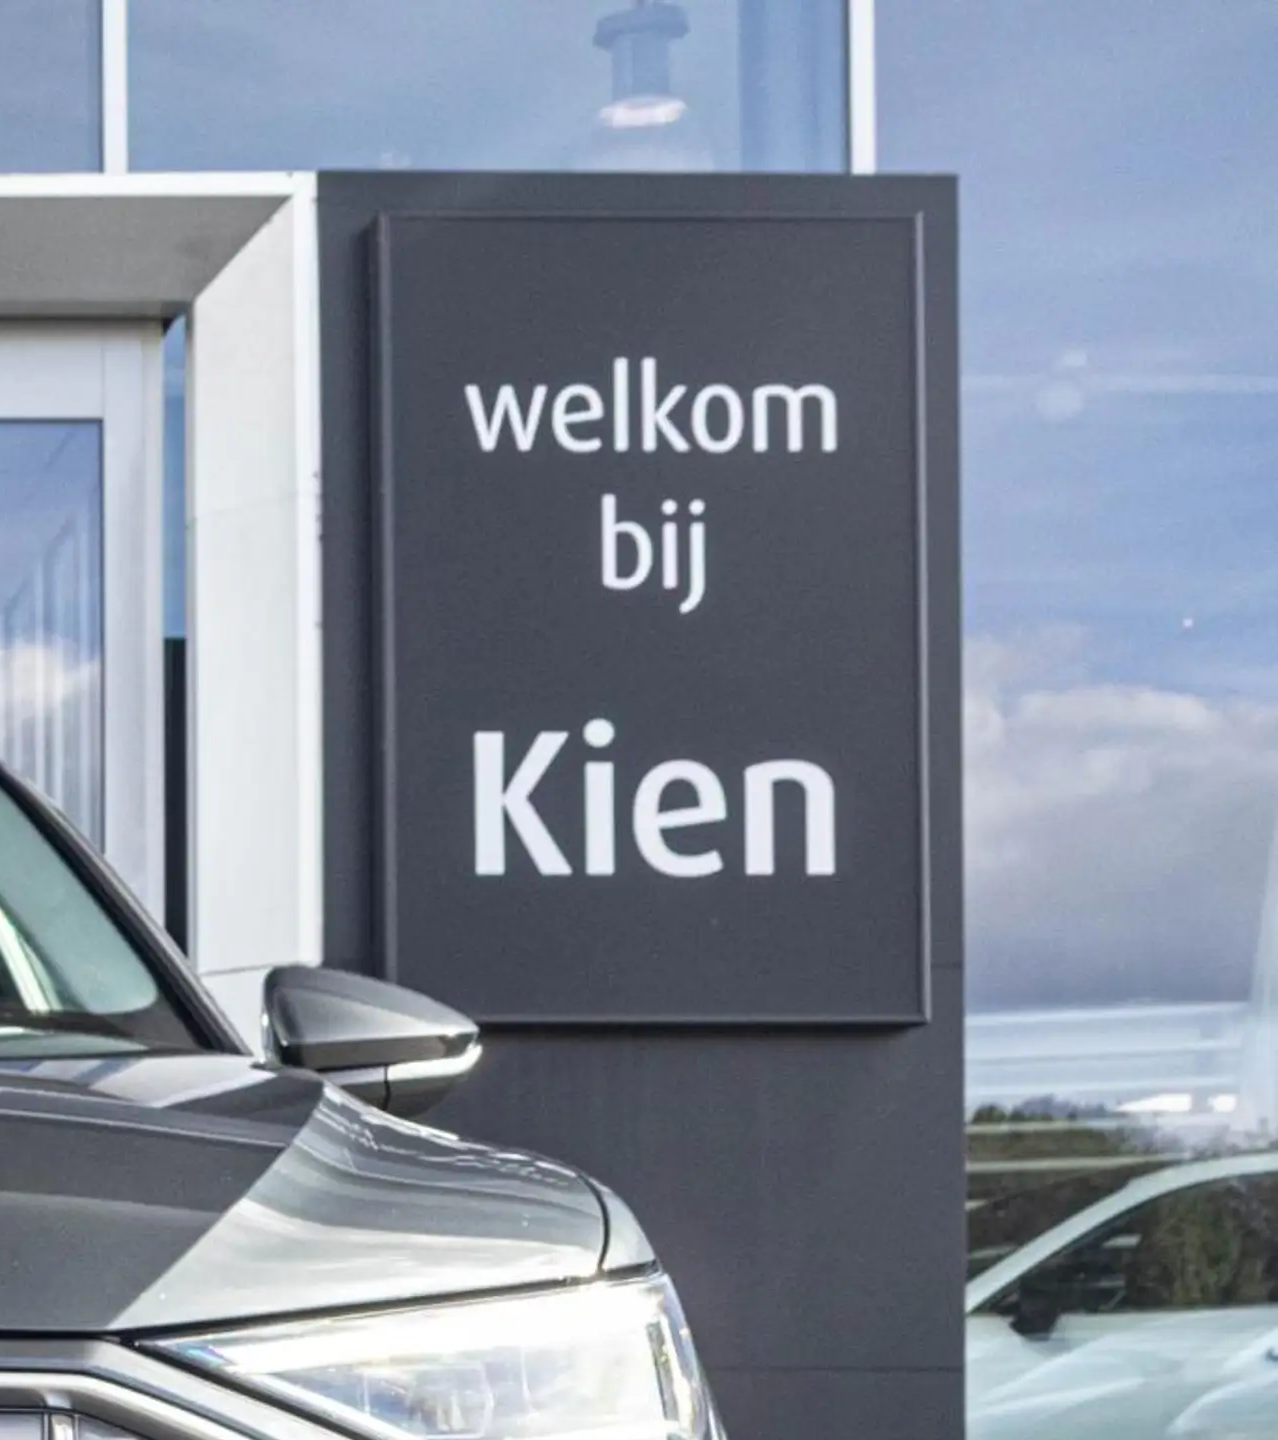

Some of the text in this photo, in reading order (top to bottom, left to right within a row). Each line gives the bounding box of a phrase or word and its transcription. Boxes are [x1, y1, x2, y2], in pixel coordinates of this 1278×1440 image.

[464, 356, 838, 454] welkom
[600, 493, 706, 614] bij
[473, 718, 836, 878] Kien
